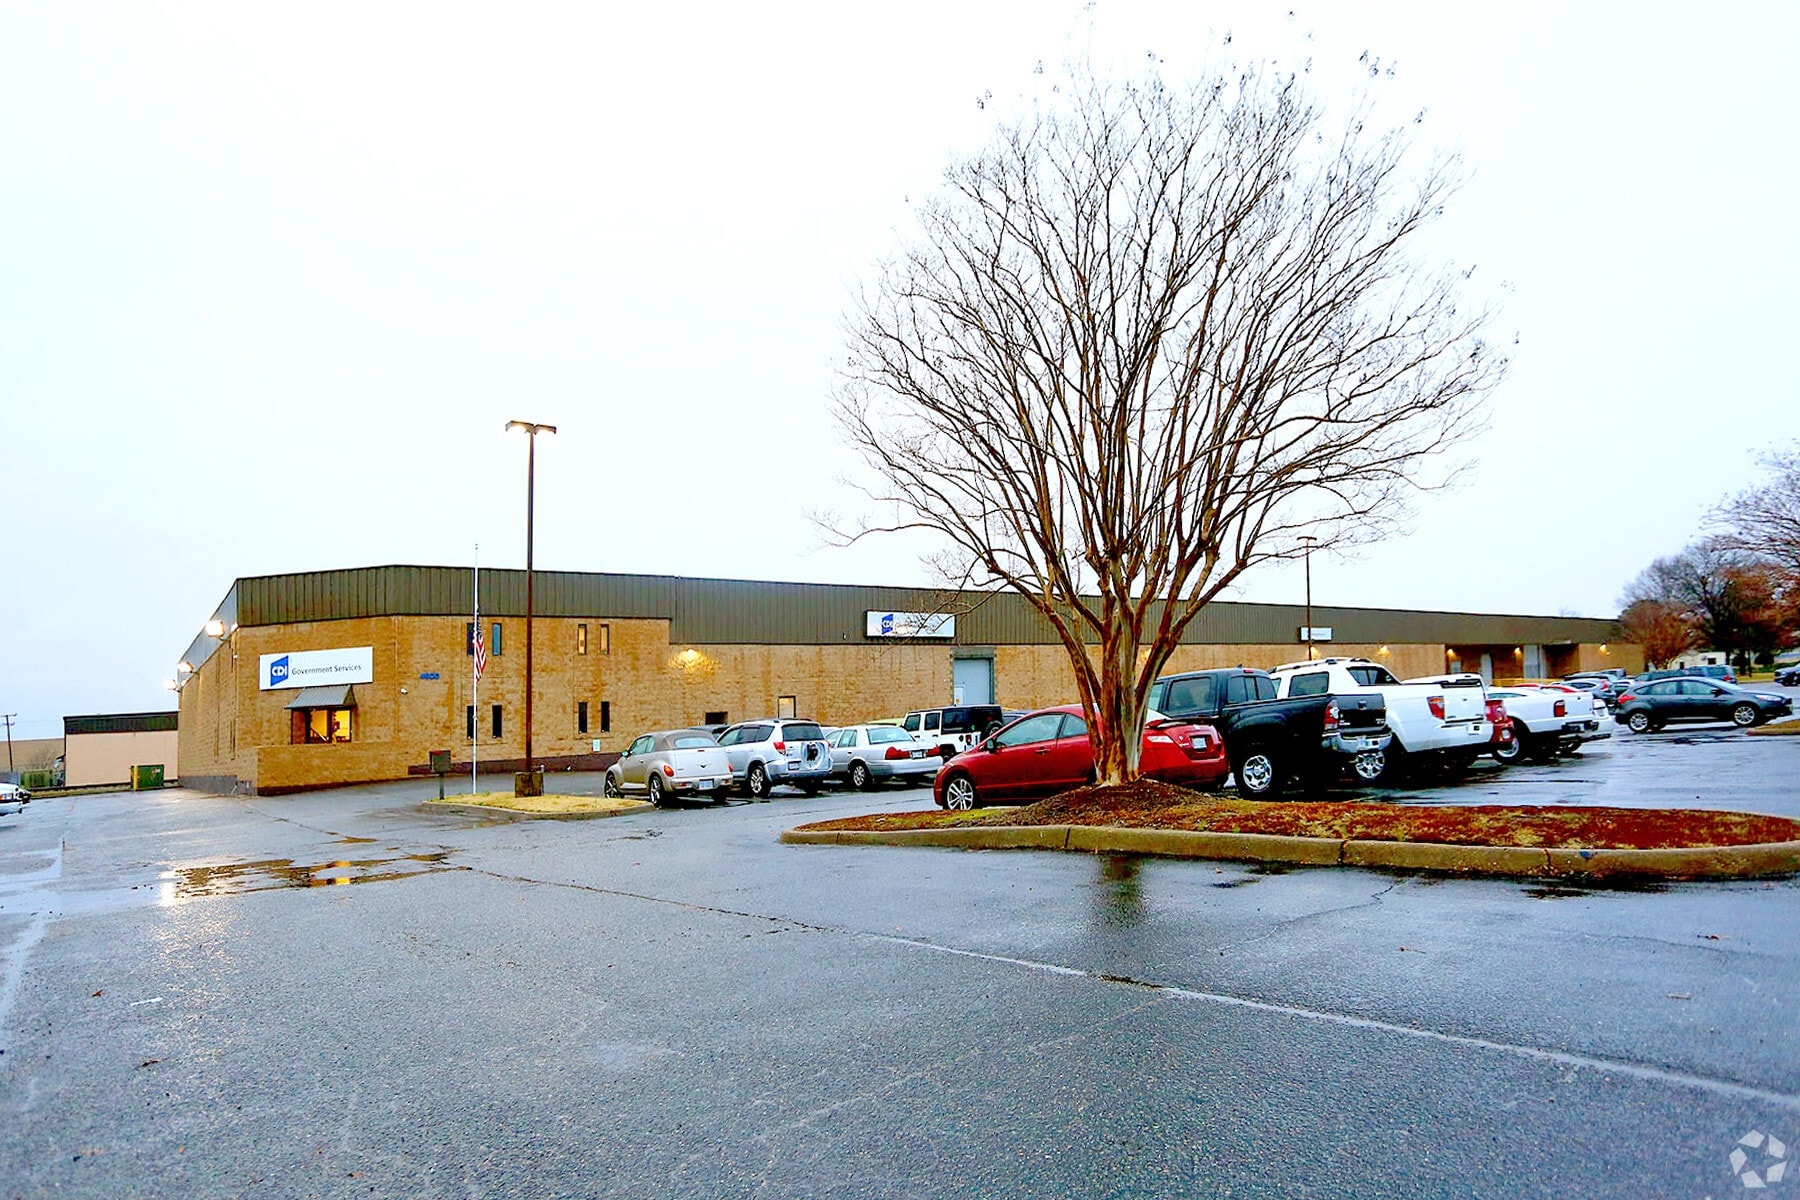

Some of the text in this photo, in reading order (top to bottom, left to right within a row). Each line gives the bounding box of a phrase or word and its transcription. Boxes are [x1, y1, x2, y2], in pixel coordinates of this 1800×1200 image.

[271, 665, 287, 676] CDI
[291, 664, 362, 675] Government Services
